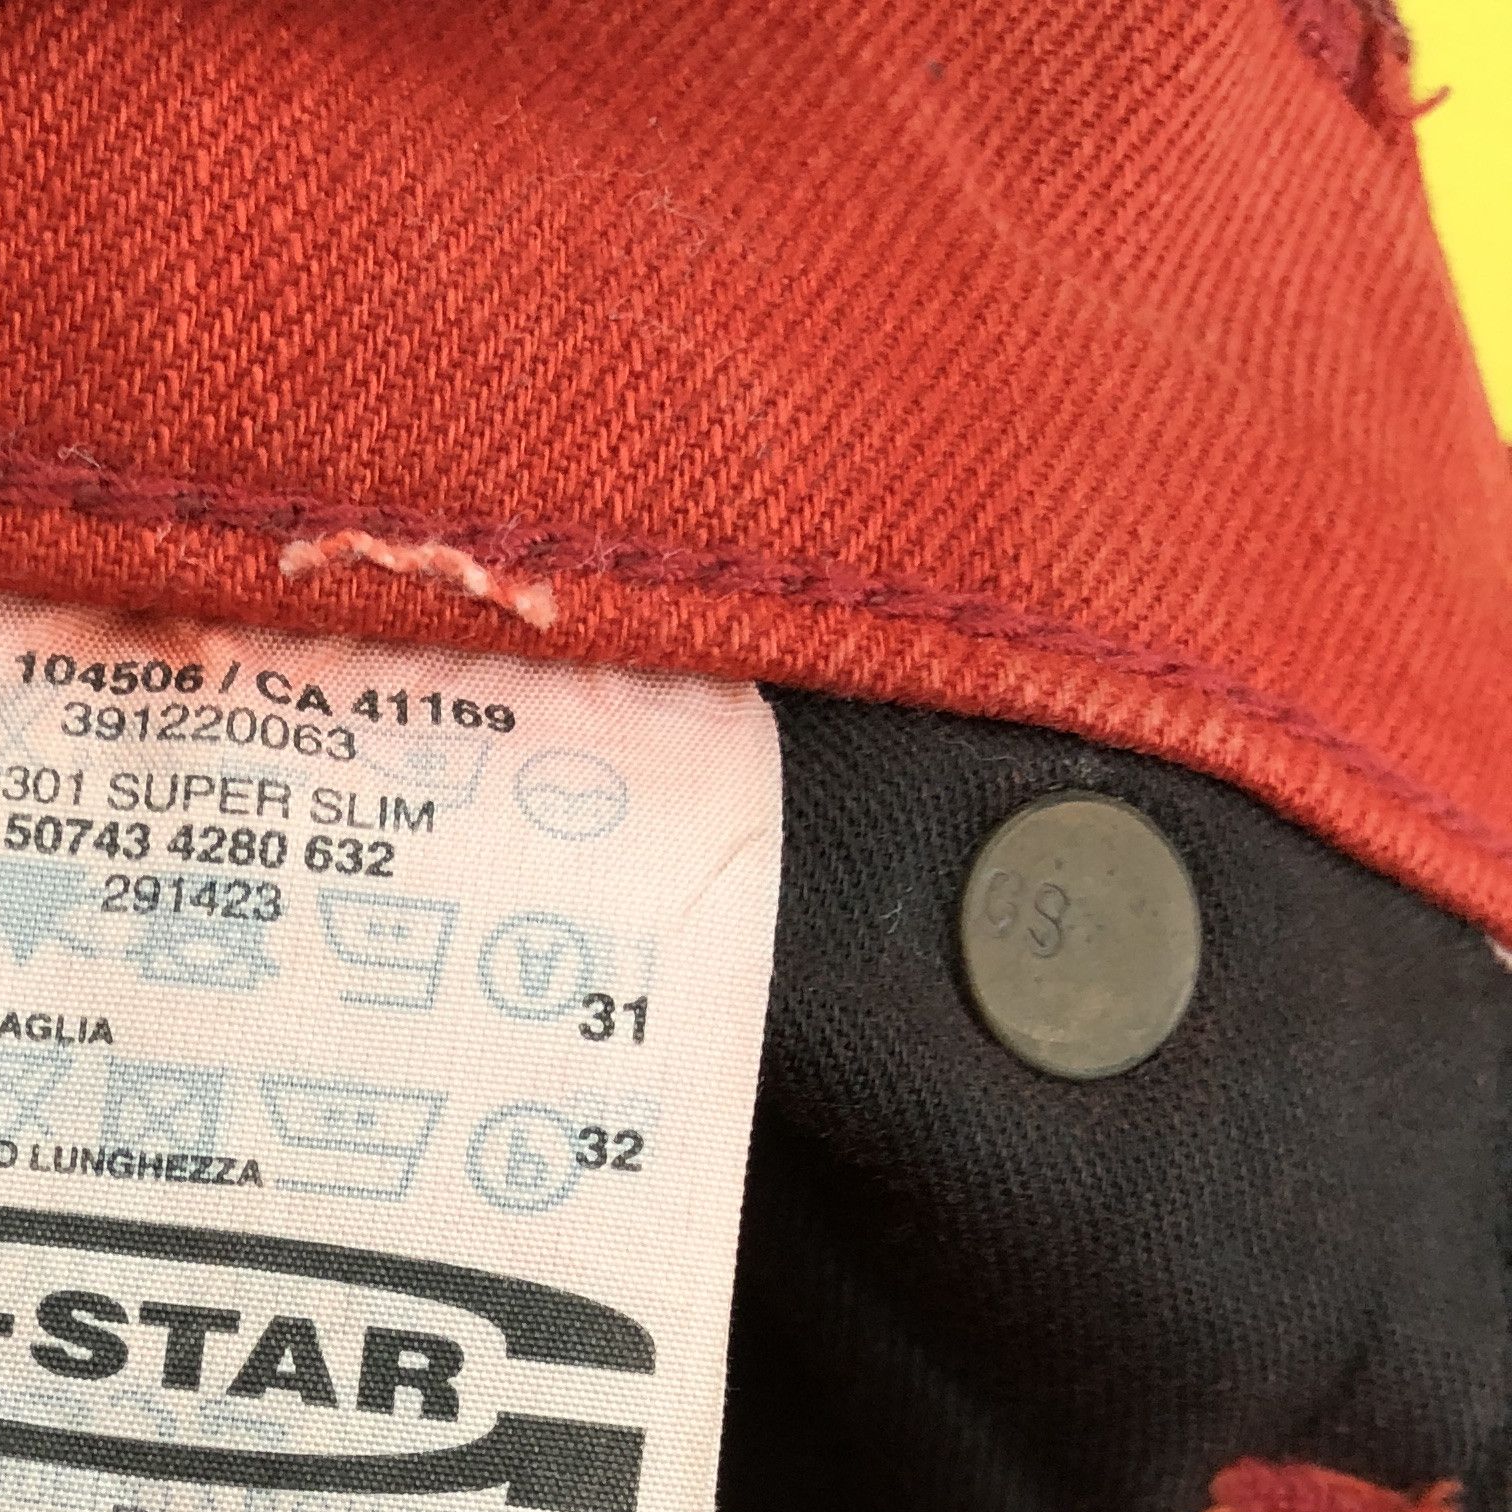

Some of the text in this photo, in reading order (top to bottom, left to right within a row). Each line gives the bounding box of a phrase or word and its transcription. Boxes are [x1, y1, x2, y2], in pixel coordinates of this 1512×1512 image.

[17, 651, 203, 694] 104506
[257, 670, 332, 717] CA
[352, 690, 516, 733] 41169
[61, 702, 356, 761] 391220063
[108, 773, 291, 819] SUPER
[311, 789, 434, 833] SLIM
[4, 813, 395, 877] 50743 4280 632
[102, 875, 283, 921] 291423
[579, 993, 650, 1046] 31
[30, 1144, 264, 1189] LUNGHEZZA
[577, 1126, 644, 1174] 32
